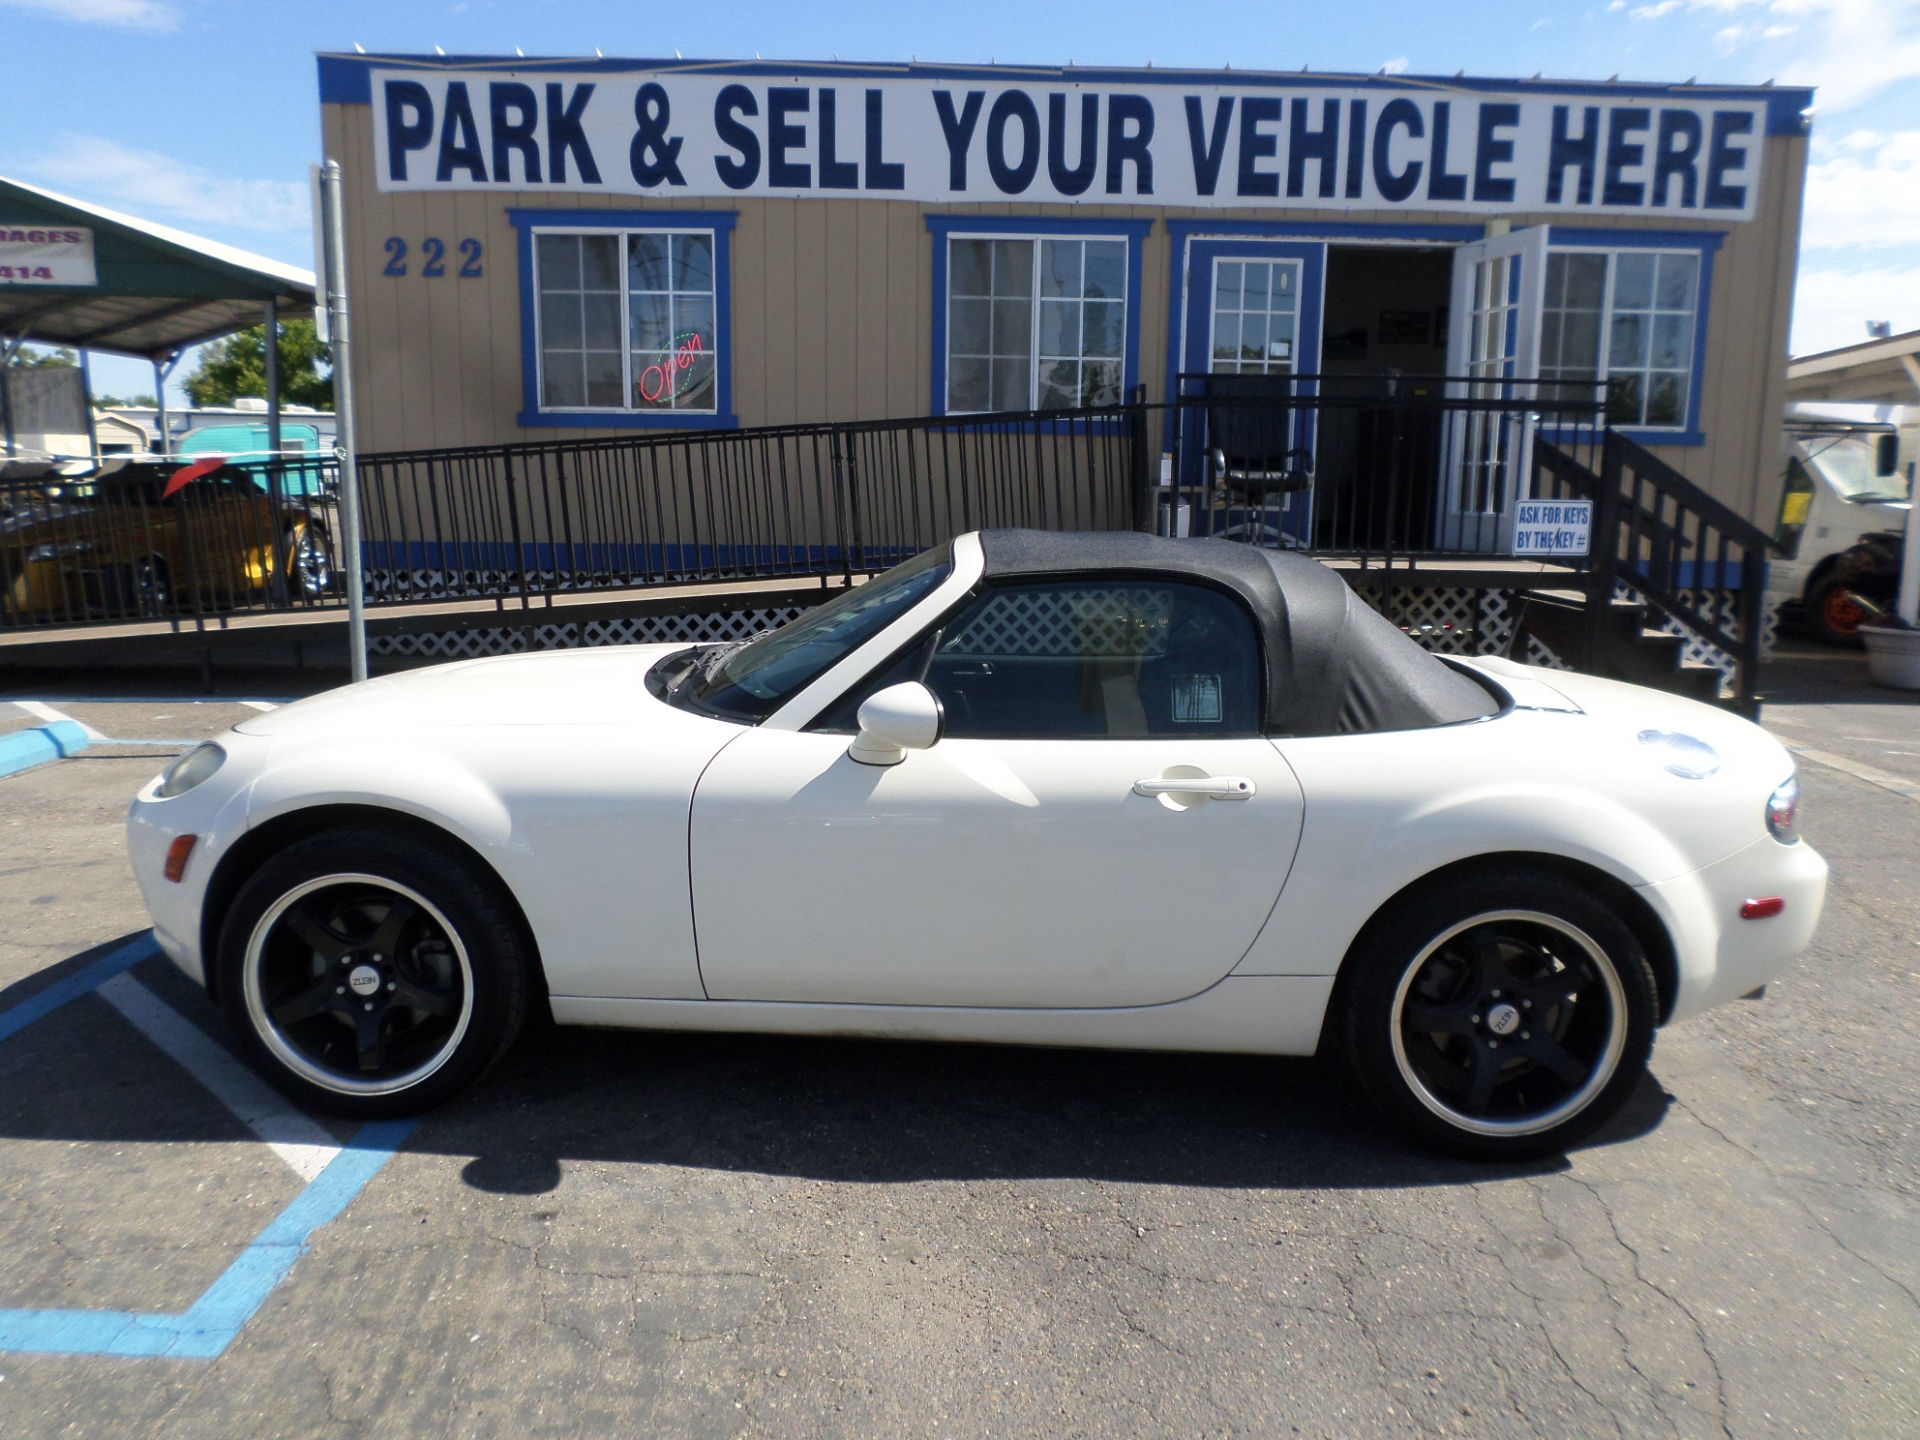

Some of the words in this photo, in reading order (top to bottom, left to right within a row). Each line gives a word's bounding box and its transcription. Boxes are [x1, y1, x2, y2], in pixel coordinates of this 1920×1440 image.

[384, 80, 603, 185] PARK
[629, 81, 688, 189] &
[713, 83, 906, 190] SELL
[931, 89, 1155, 196] YOUR
[1183, 96, 1521, 203] VEHICLE
[1544, 105, 1755, 210] HERE
[383, 236, 484, 277] 222
[640, 332, 704, 401] Open
[1519, 506, 1541, 524] ASK
[1542, 506, 1562, 524] FOR
[1564, 507, 1588, 524] KEYS
[1517, 532, 1532, 548] BY
[1534, 532, 1553, 548] THE
[1555, 531, 1576, 549] KEY
[1577, 534, 1586, 548] #
